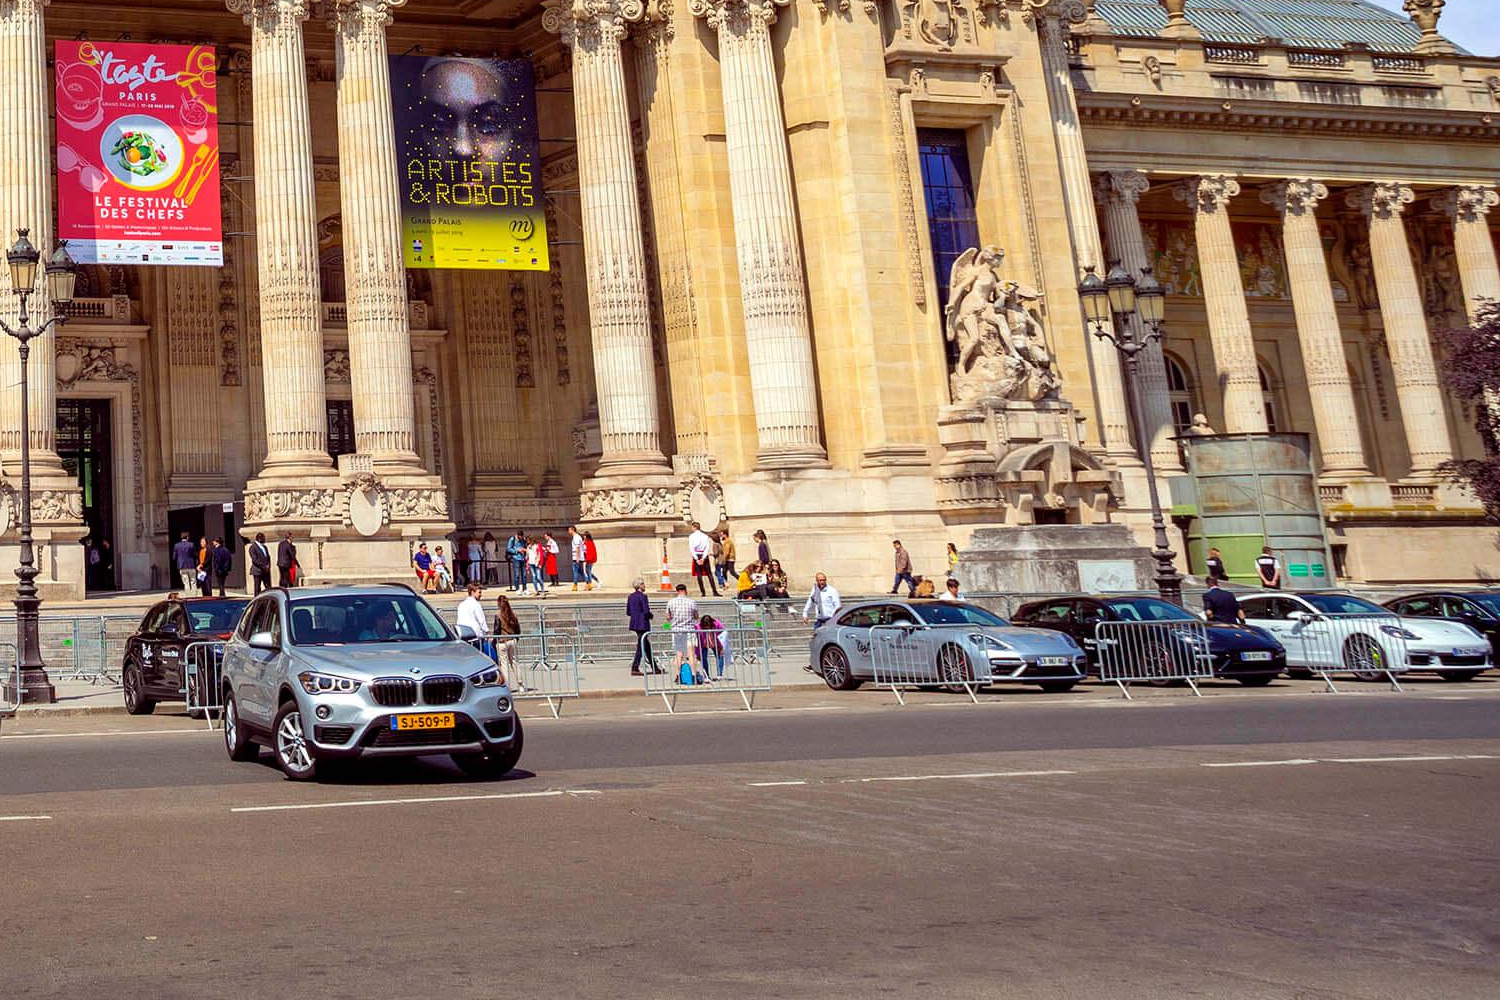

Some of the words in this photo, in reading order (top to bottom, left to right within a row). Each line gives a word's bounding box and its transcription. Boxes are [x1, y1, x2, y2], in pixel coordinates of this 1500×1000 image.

[119, 91, 157, 101] PARIS
[407, 158, 532, 184] ARTISTES
[409, 182, 431, 204] &
[435, 183, 534, 207] ROBOTS
[95, 196, 112, 207] LE
[118, 197, 188, 208] FESTIVAL
[100, 208, 128, 218] DES
[136, 209, 184, 220] CHEFS
[411, 217, 436, 225] GRAND
